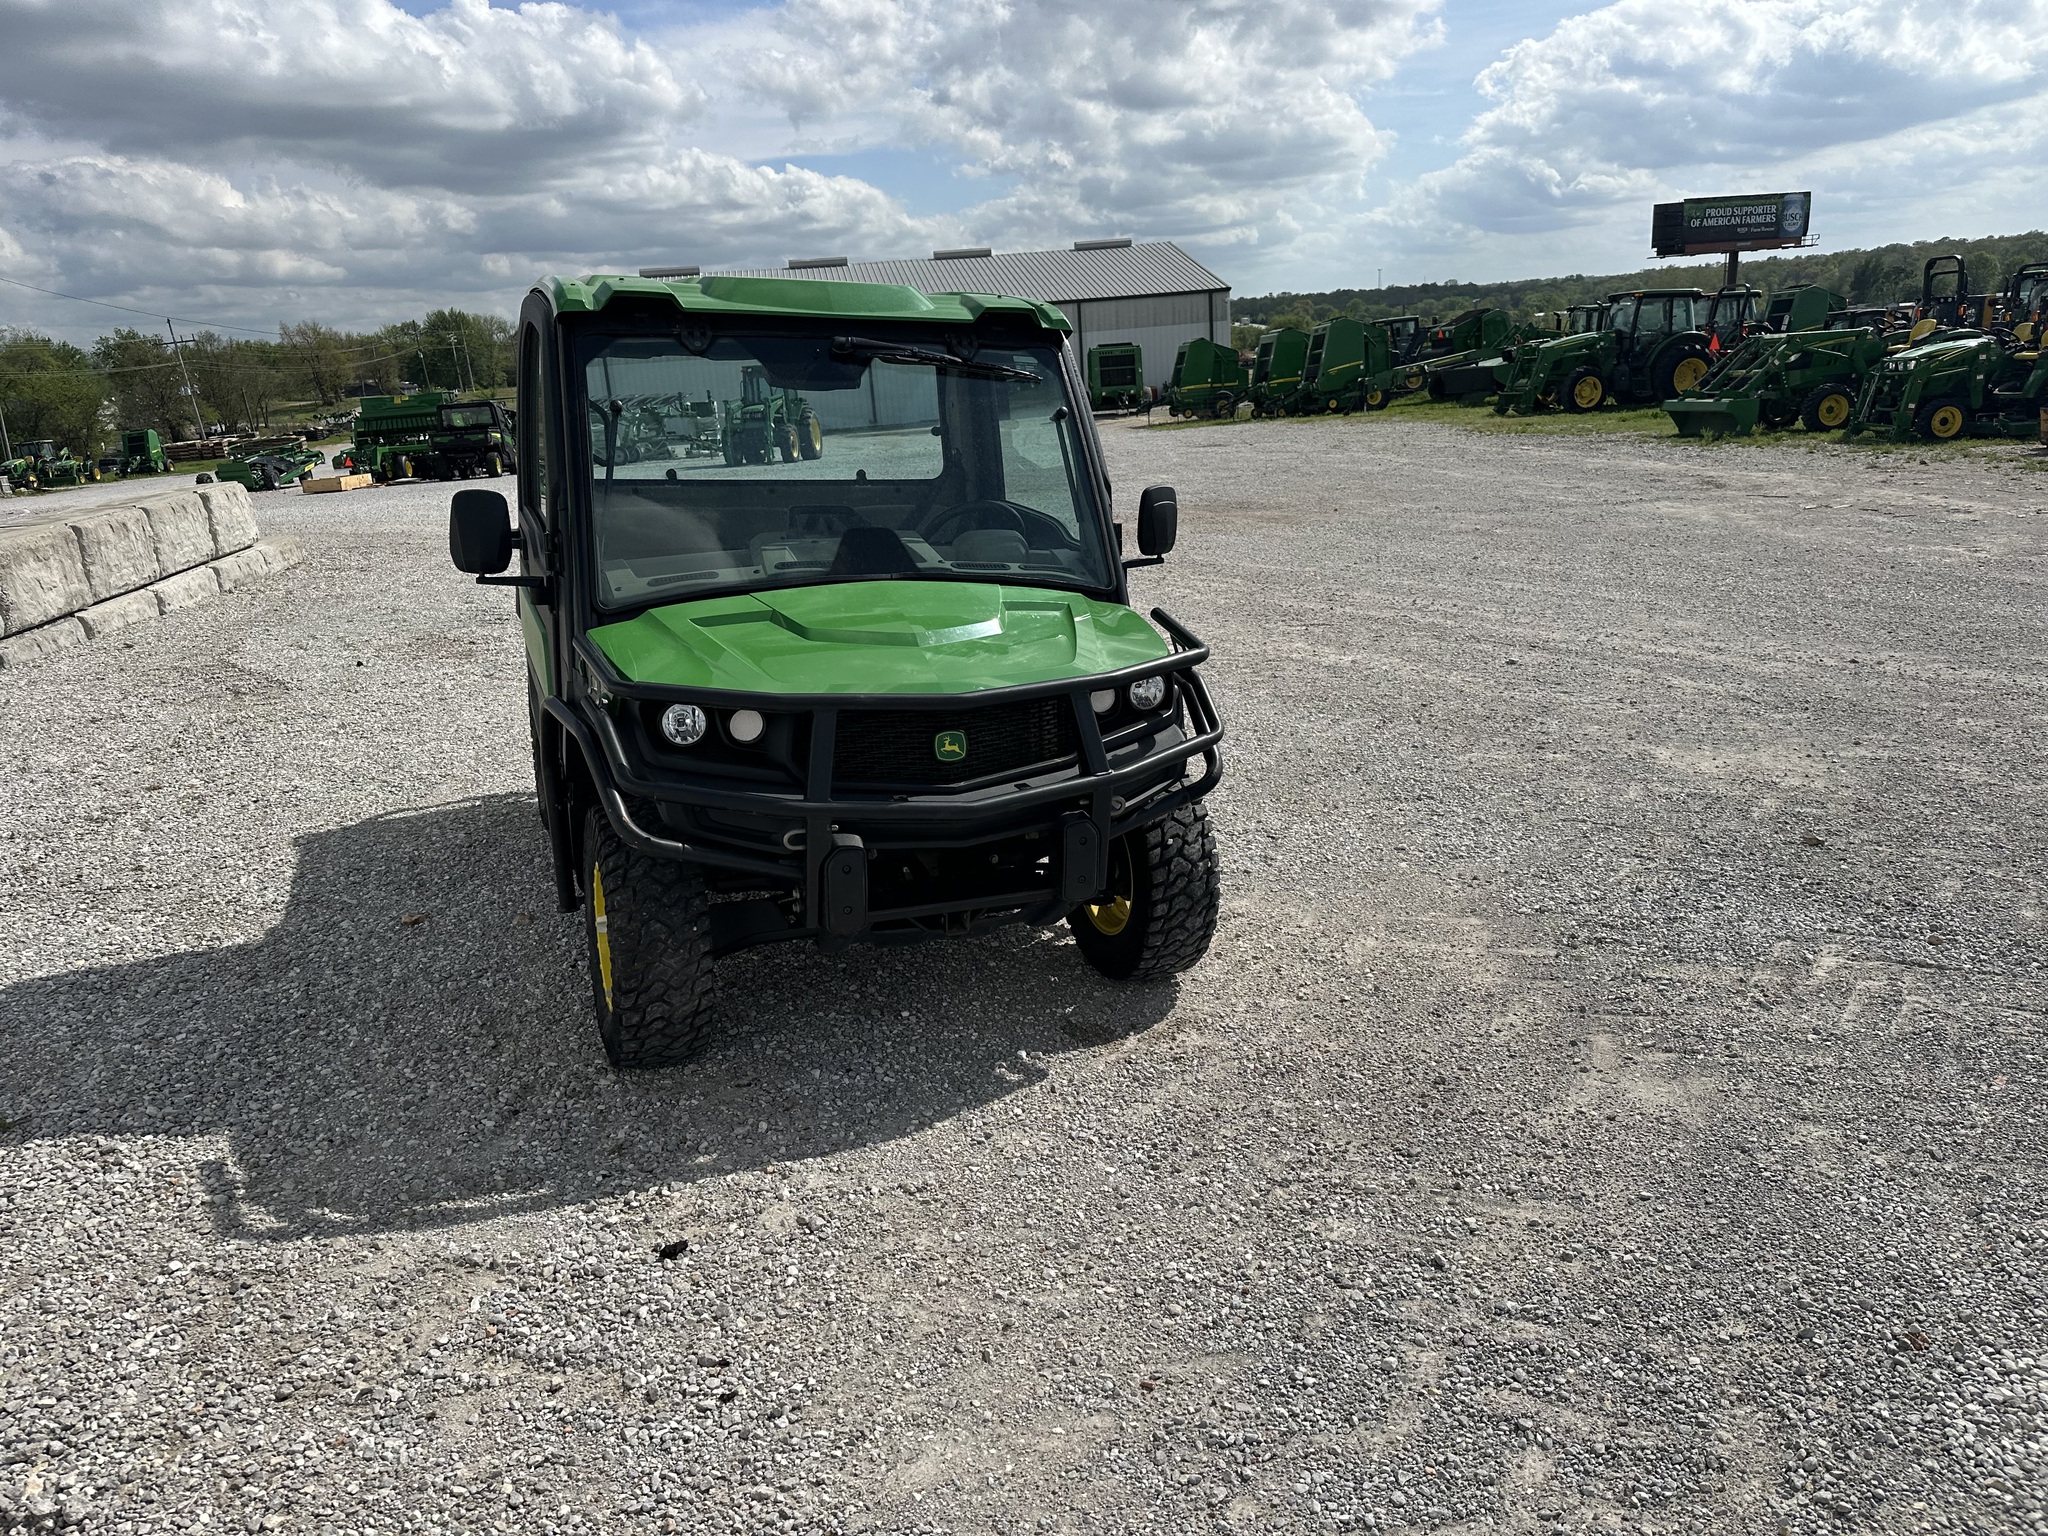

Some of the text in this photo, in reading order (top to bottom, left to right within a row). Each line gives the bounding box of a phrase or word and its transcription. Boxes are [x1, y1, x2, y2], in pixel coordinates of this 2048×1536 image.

[1705, 204, 1777, 217] PROUD SUPPORTER
[1690, 213, 1777, 228] OF AMERICAN FARMERS
